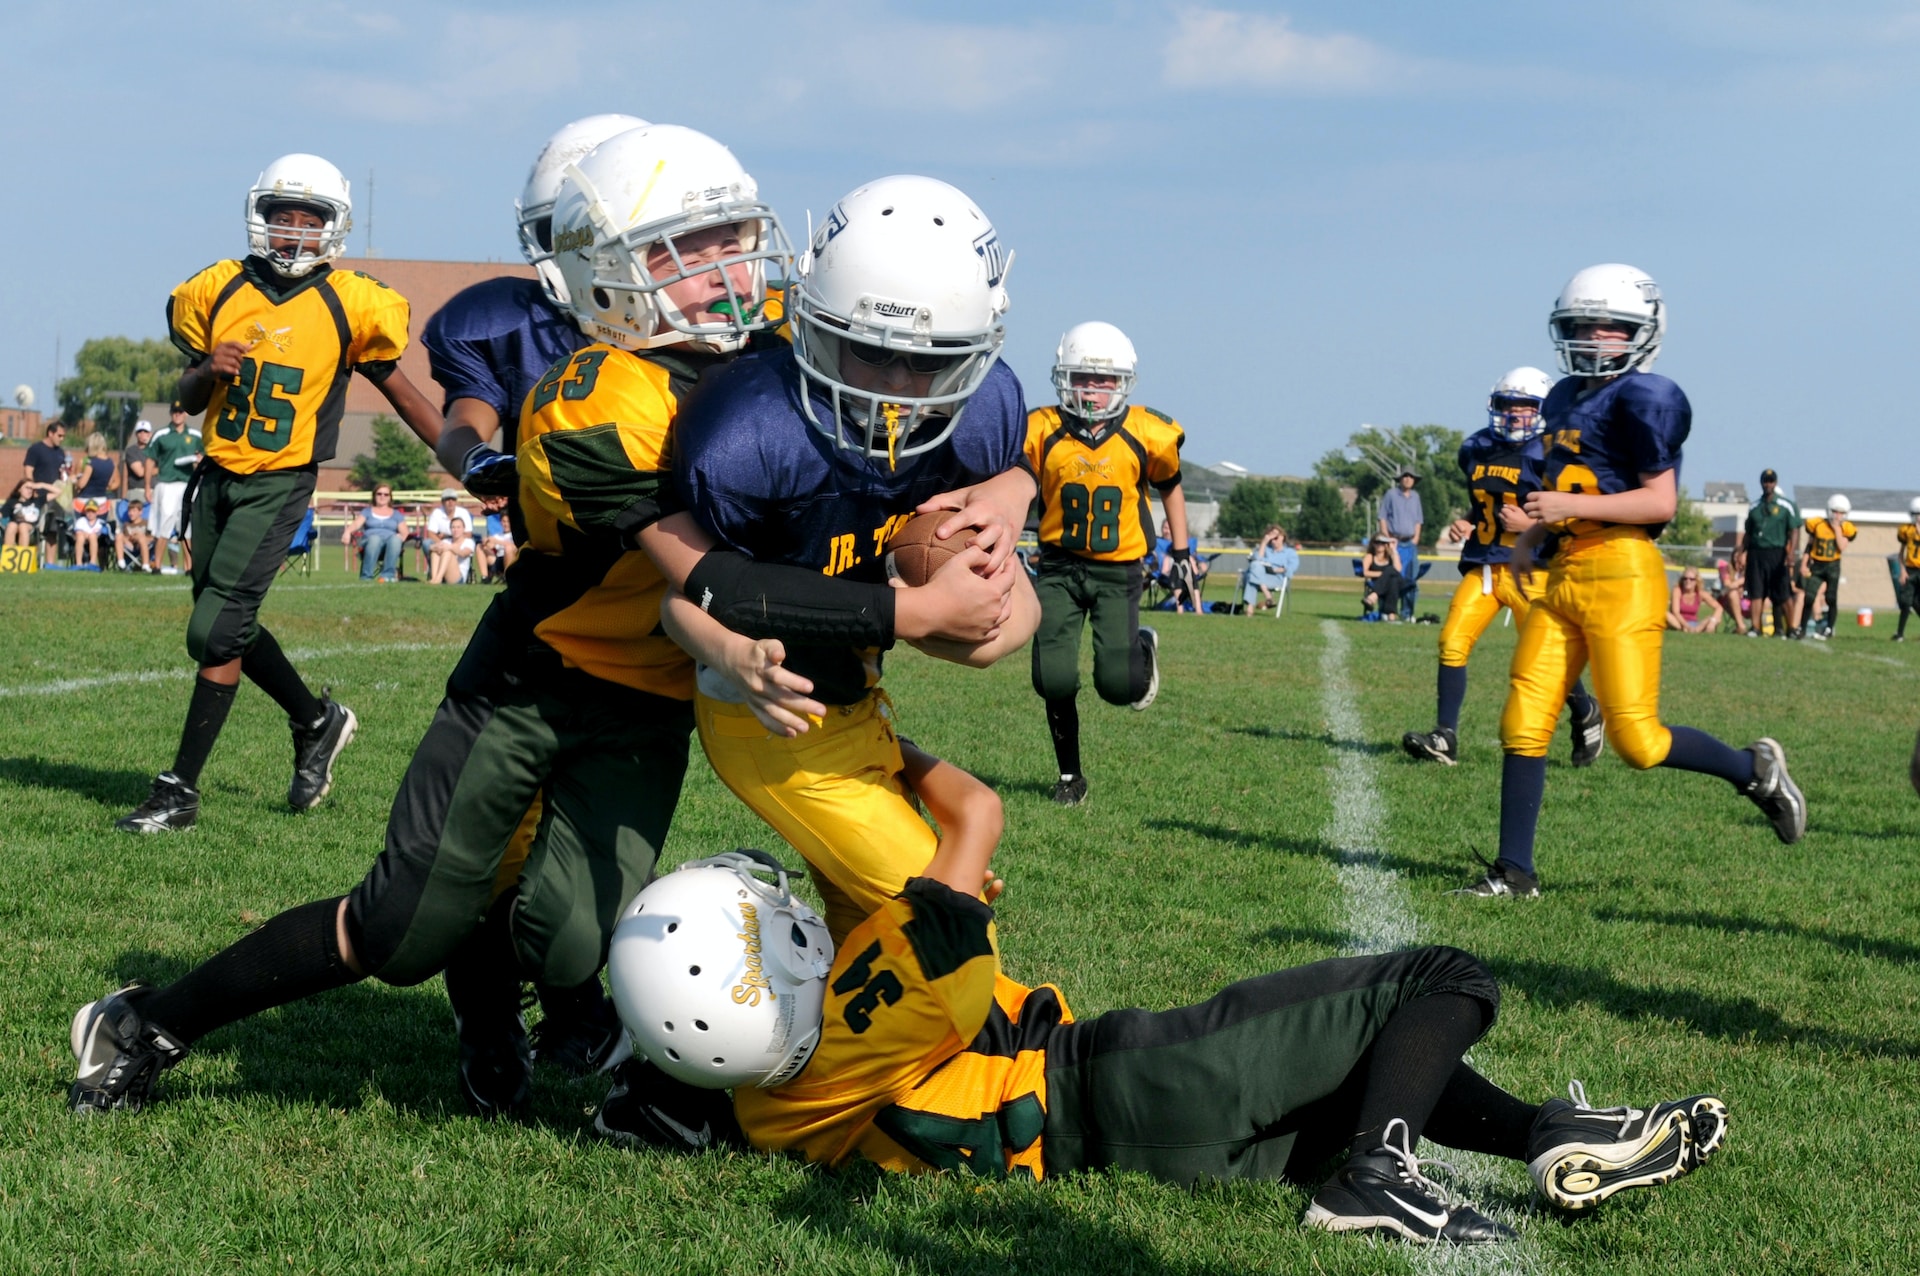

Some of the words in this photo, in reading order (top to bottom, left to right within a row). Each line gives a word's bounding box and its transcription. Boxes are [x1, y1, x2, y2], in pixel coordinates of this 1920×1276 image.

[873, 302, 917, 317] schutt
[216, 357, 304, 453] 35
[532, 350, 609, 415] 23
[1060, 483, 1123, 553] 88
[2, 548, 32, 572] 30
[823, 532, 861, 577] JR.
[731, 902, 769, 1008] Spartans
